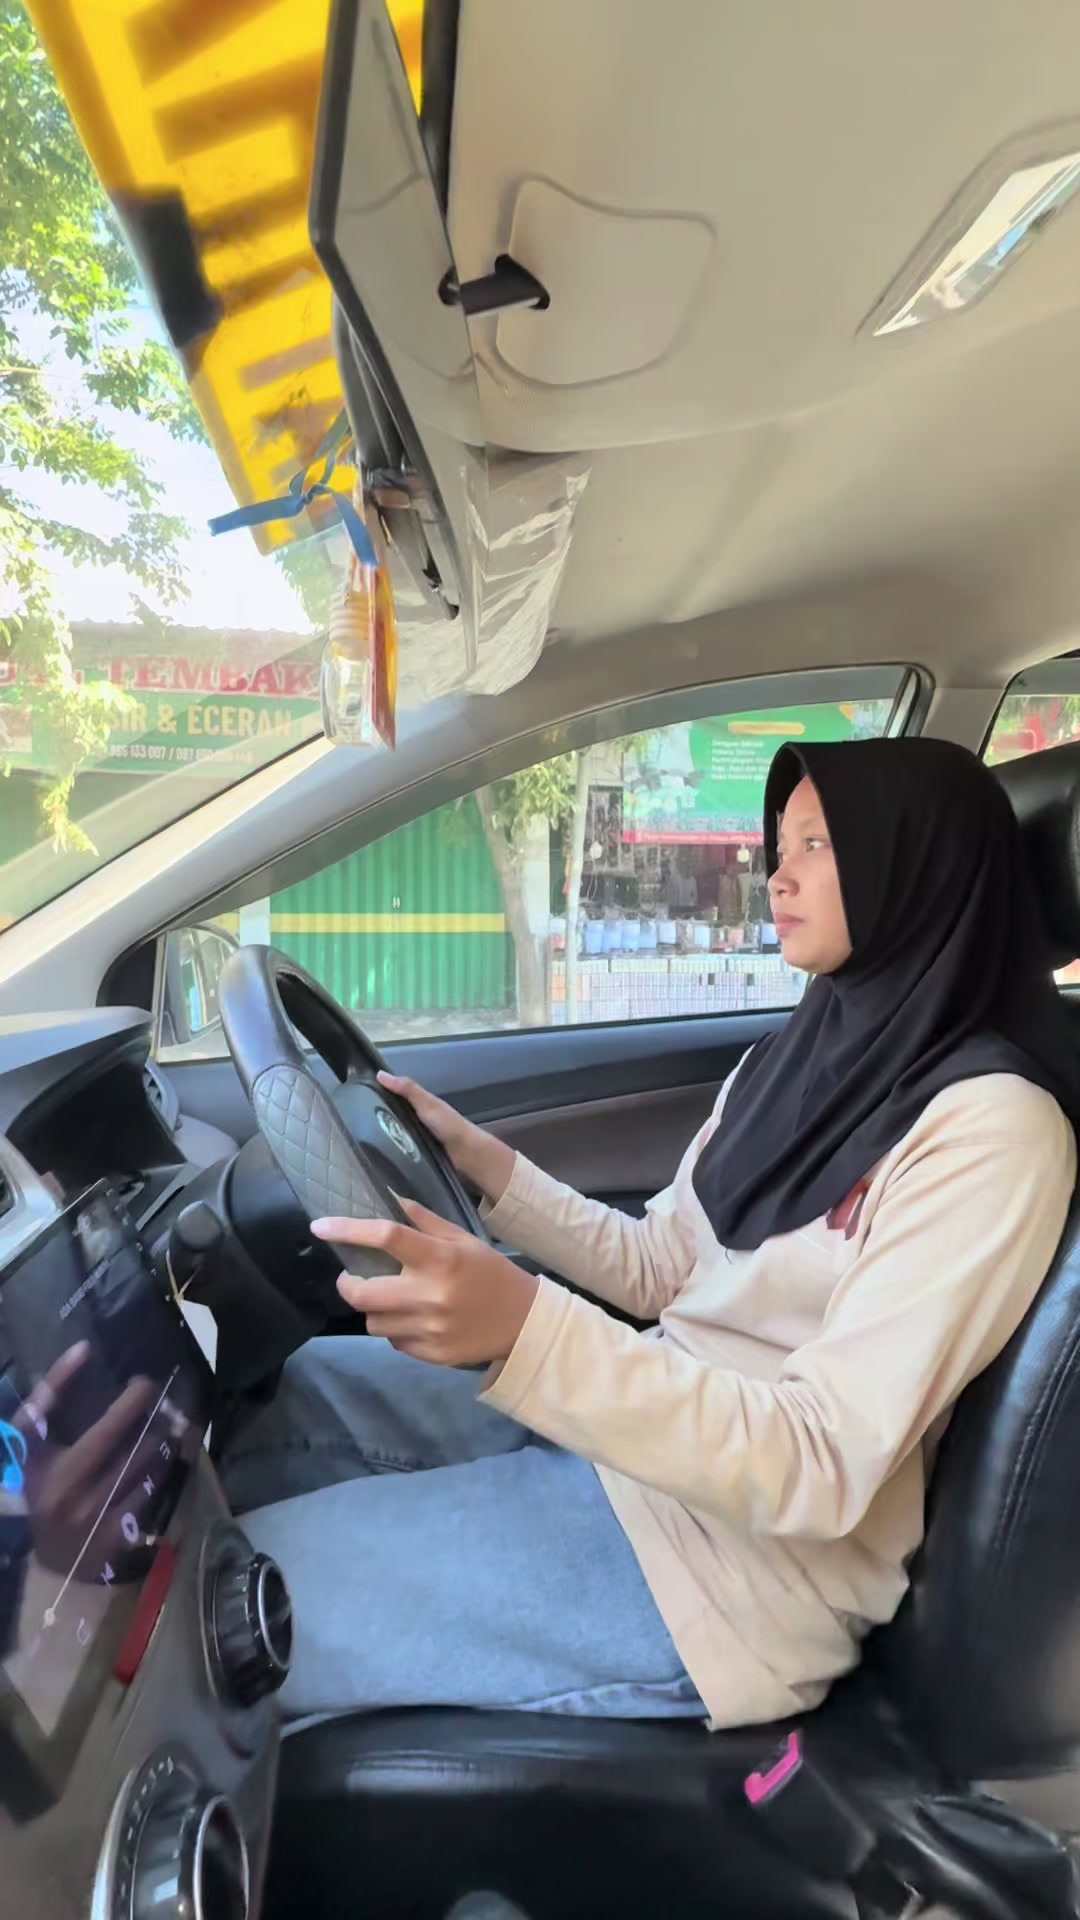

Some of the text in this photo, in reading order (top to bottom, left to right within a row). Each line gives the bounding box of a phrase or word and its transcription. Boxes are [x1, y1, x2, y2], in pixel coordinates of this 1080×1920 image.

[99, 656, 322, 699] TEMBAK
[157, 702, 178, 734] &
[187, 704, 293, 738] ECERAN
